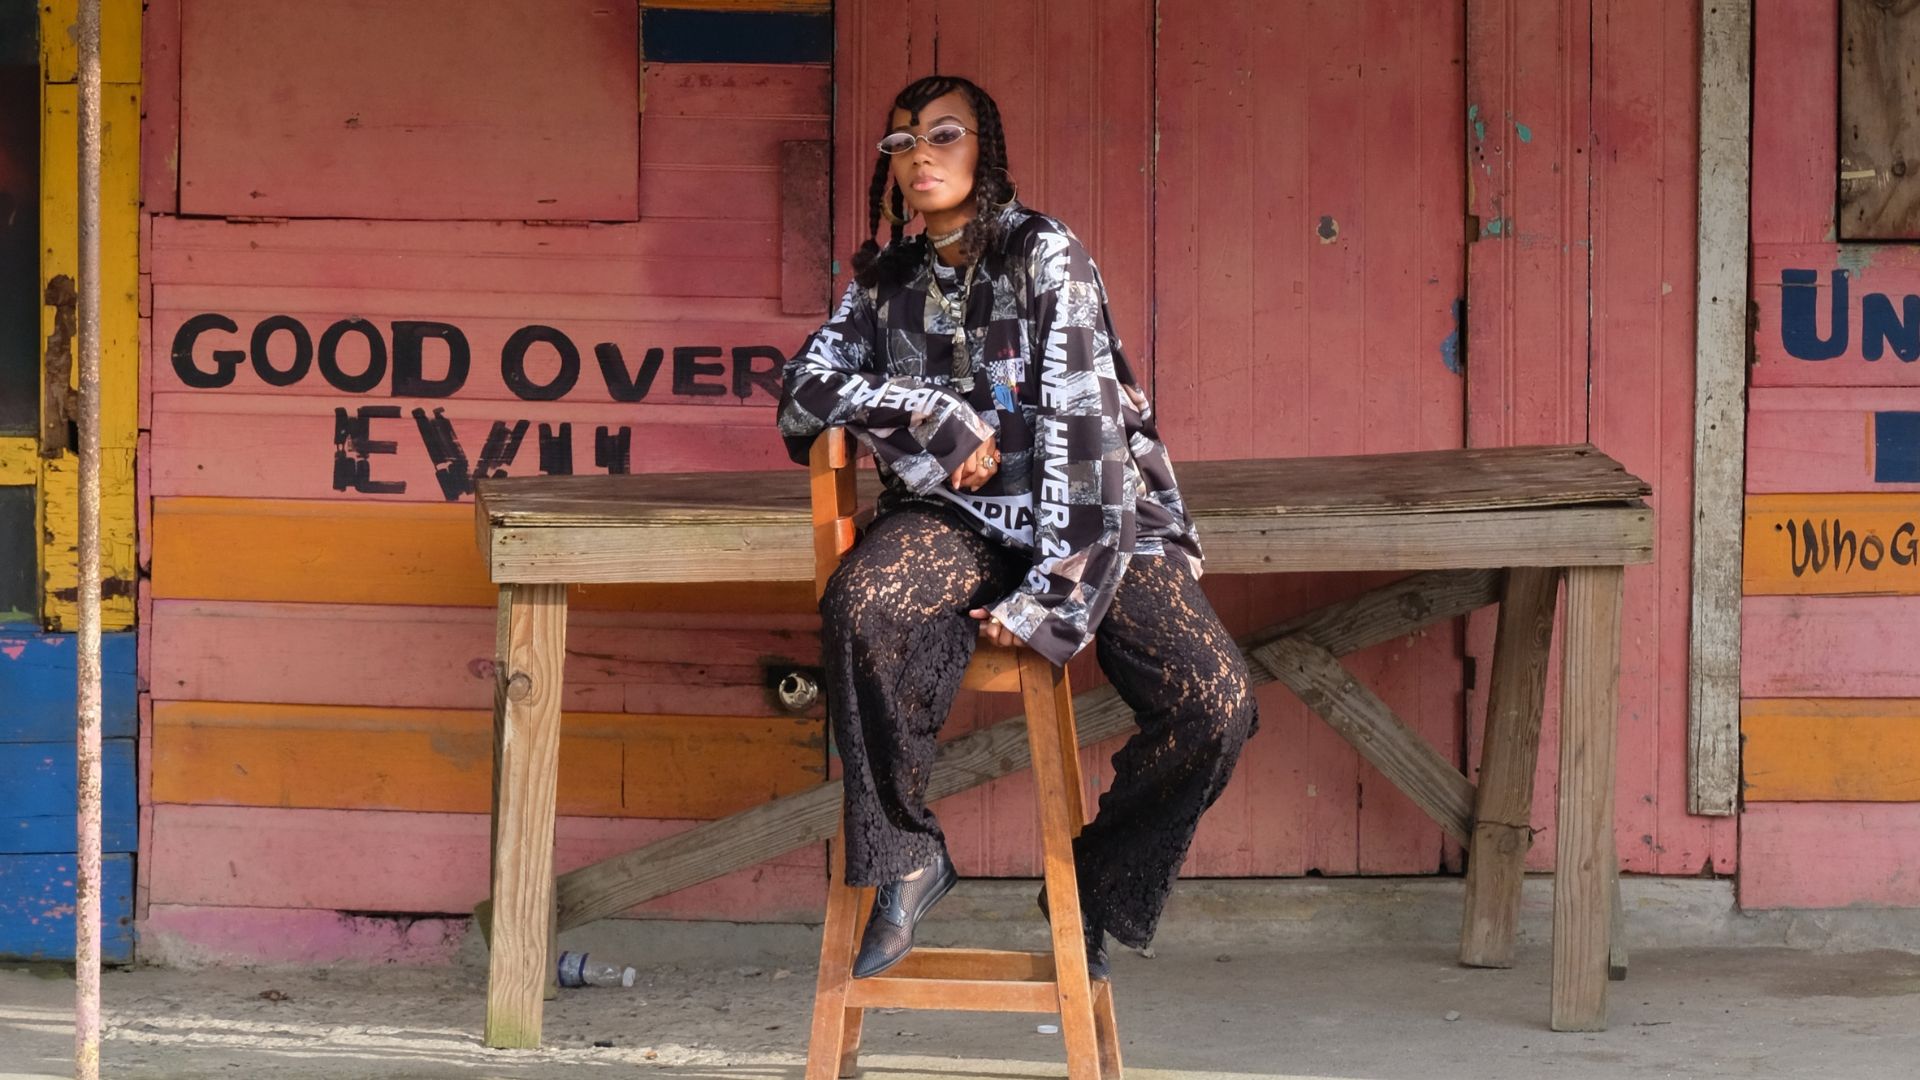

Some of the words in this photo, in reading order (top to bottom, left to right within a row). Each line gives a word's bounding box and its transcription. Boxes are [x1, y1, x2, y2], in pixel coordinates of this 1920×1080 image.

[171, 313, 471, 398] GOOD
[500, 324, 784, 403] OVER
[1041, 419, 1071, 529] HIVER
